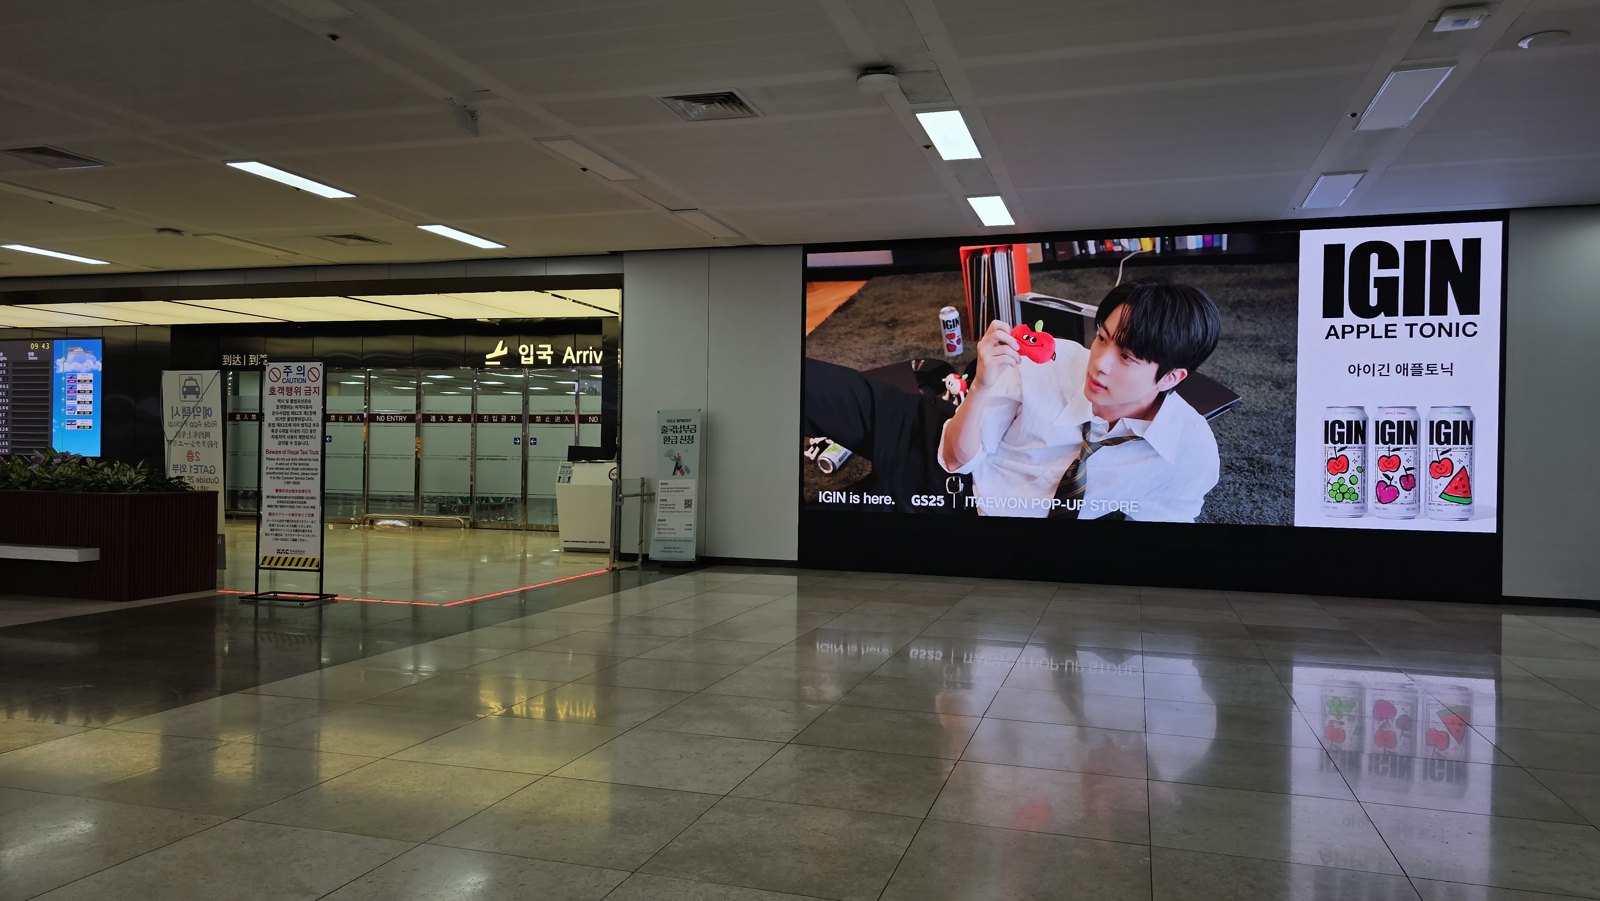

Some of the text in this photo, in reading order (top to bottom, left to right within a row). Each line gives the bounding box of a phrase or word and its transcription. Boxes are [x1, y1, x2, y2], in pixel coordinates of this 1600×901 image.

[1322, 237, 1482, 319] IGIN
[942, 318, 960, 330] IGIN
[1324, 321, 1479, 340] APPLE TONIC
[222, 354, 242, 366] 到达
[518, 344, 603, 365] 입국 Arriv
[1347, 362, 1454, 377] 아이긴 애플토닉
[268, 386, 320, 397] 호객행위 금지
[664, 435, 694, 444] 환급 신청
[1324, 420, 1367, 445] IGIN
[1375, 420, 1418, 446] IGIN
[1429, 420, 1474, 446] IGIN
[818, 491, 895, 505] IGIN is here.
[911, 495, 1139, 513] GS25 ITAEWON POP-UP STORE
